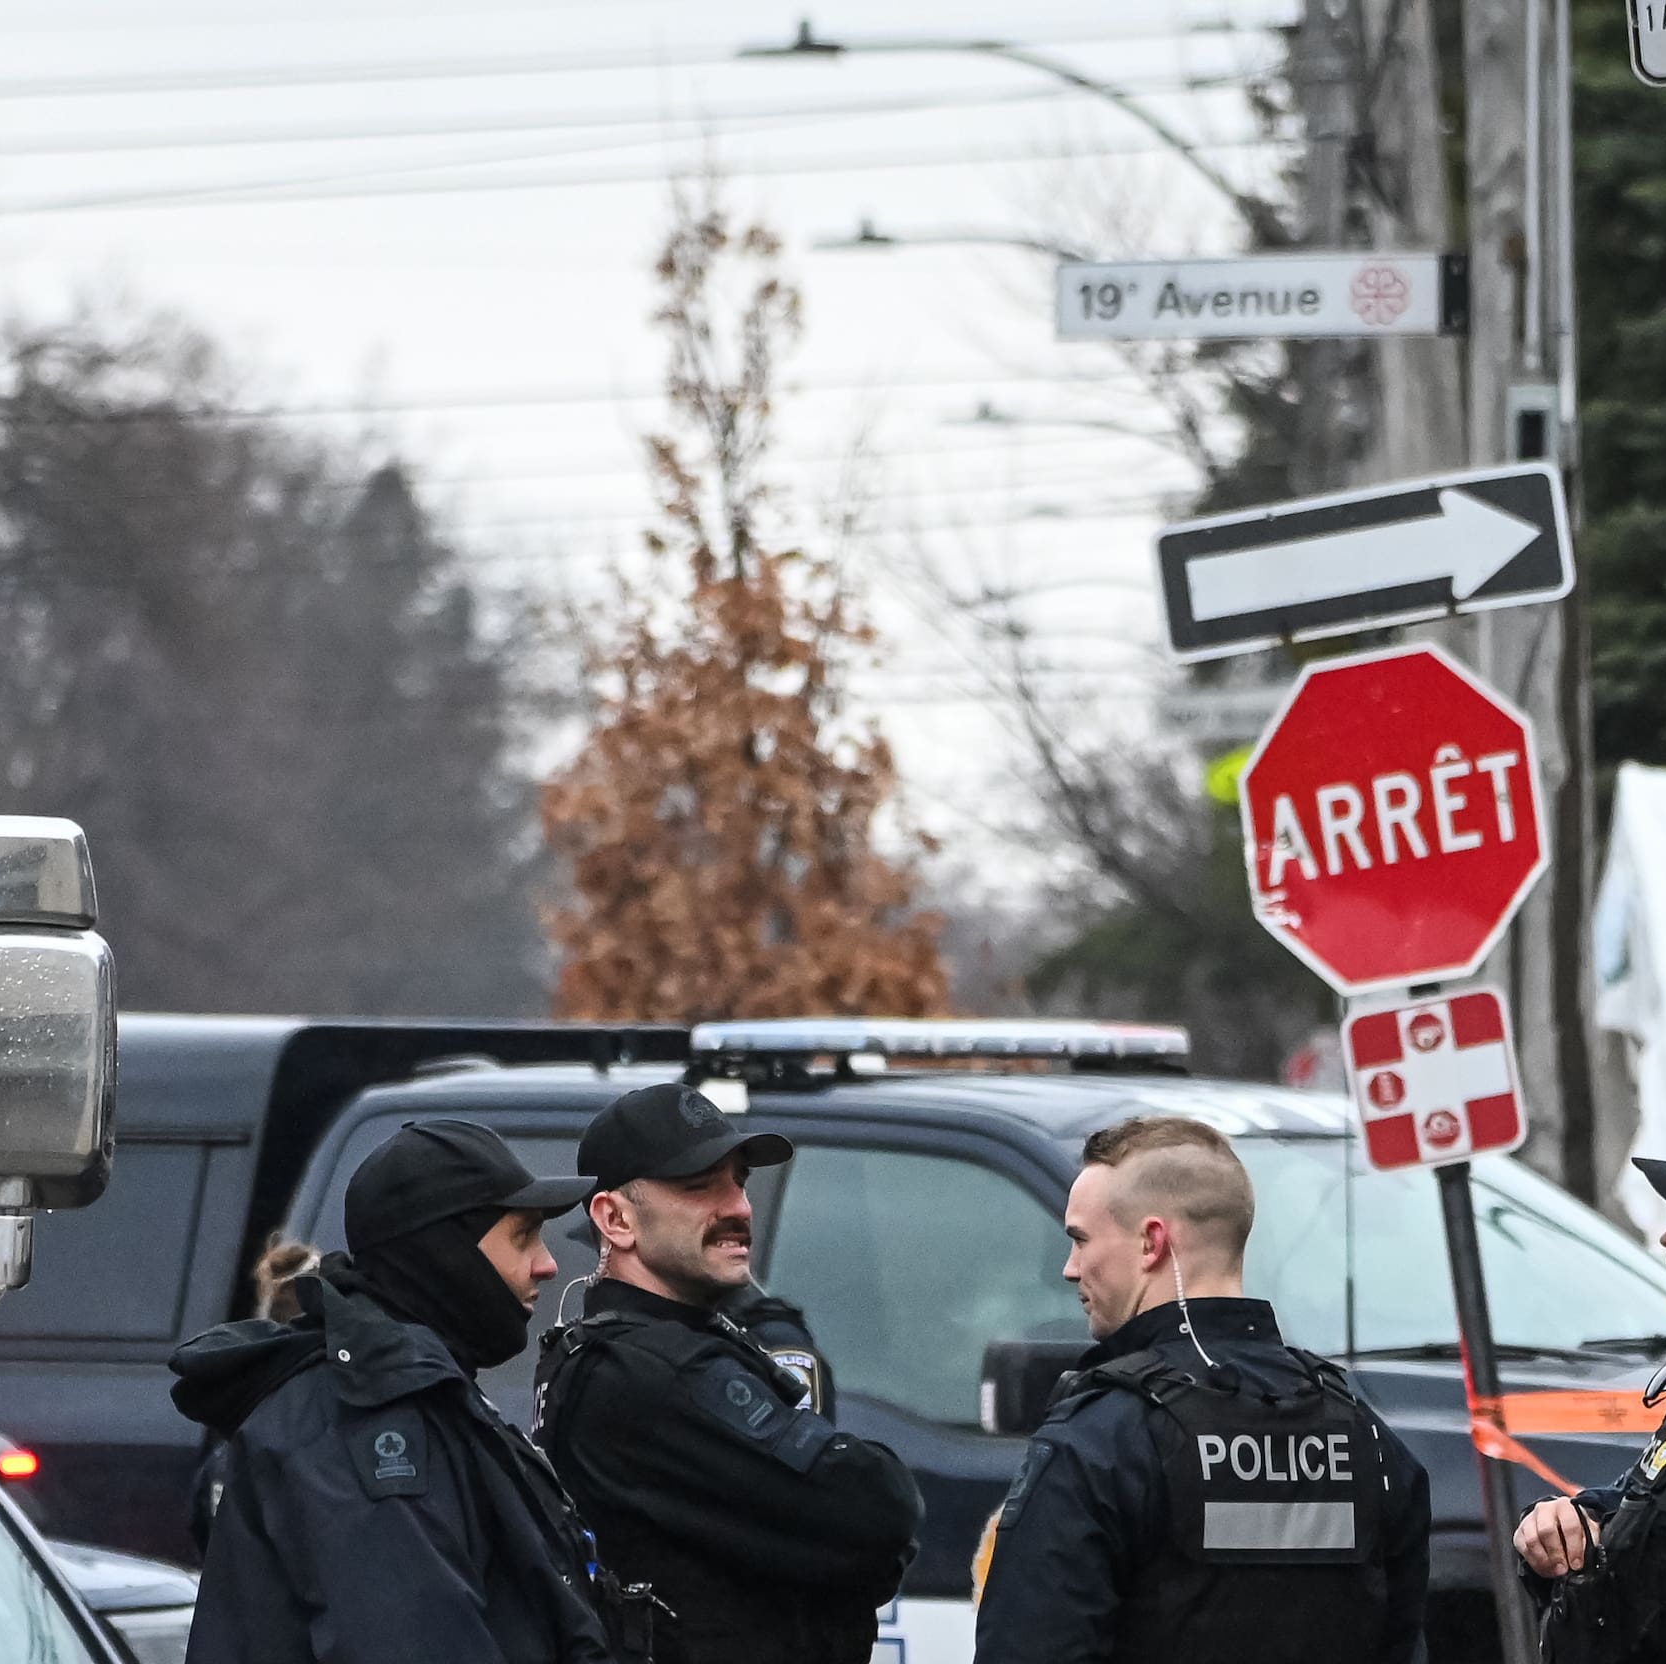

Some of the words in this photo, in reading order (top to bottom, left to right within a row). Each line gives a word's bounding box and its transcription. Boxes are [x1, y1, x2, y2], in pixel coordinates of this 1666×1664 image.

[1645, 5, 1654, 32] 1
[1153, 282, 1322, 320] Avenue
[1268, 742, 1520, 888] ARRÊT
[1196, 1434, 1354, 1482] POLICE
